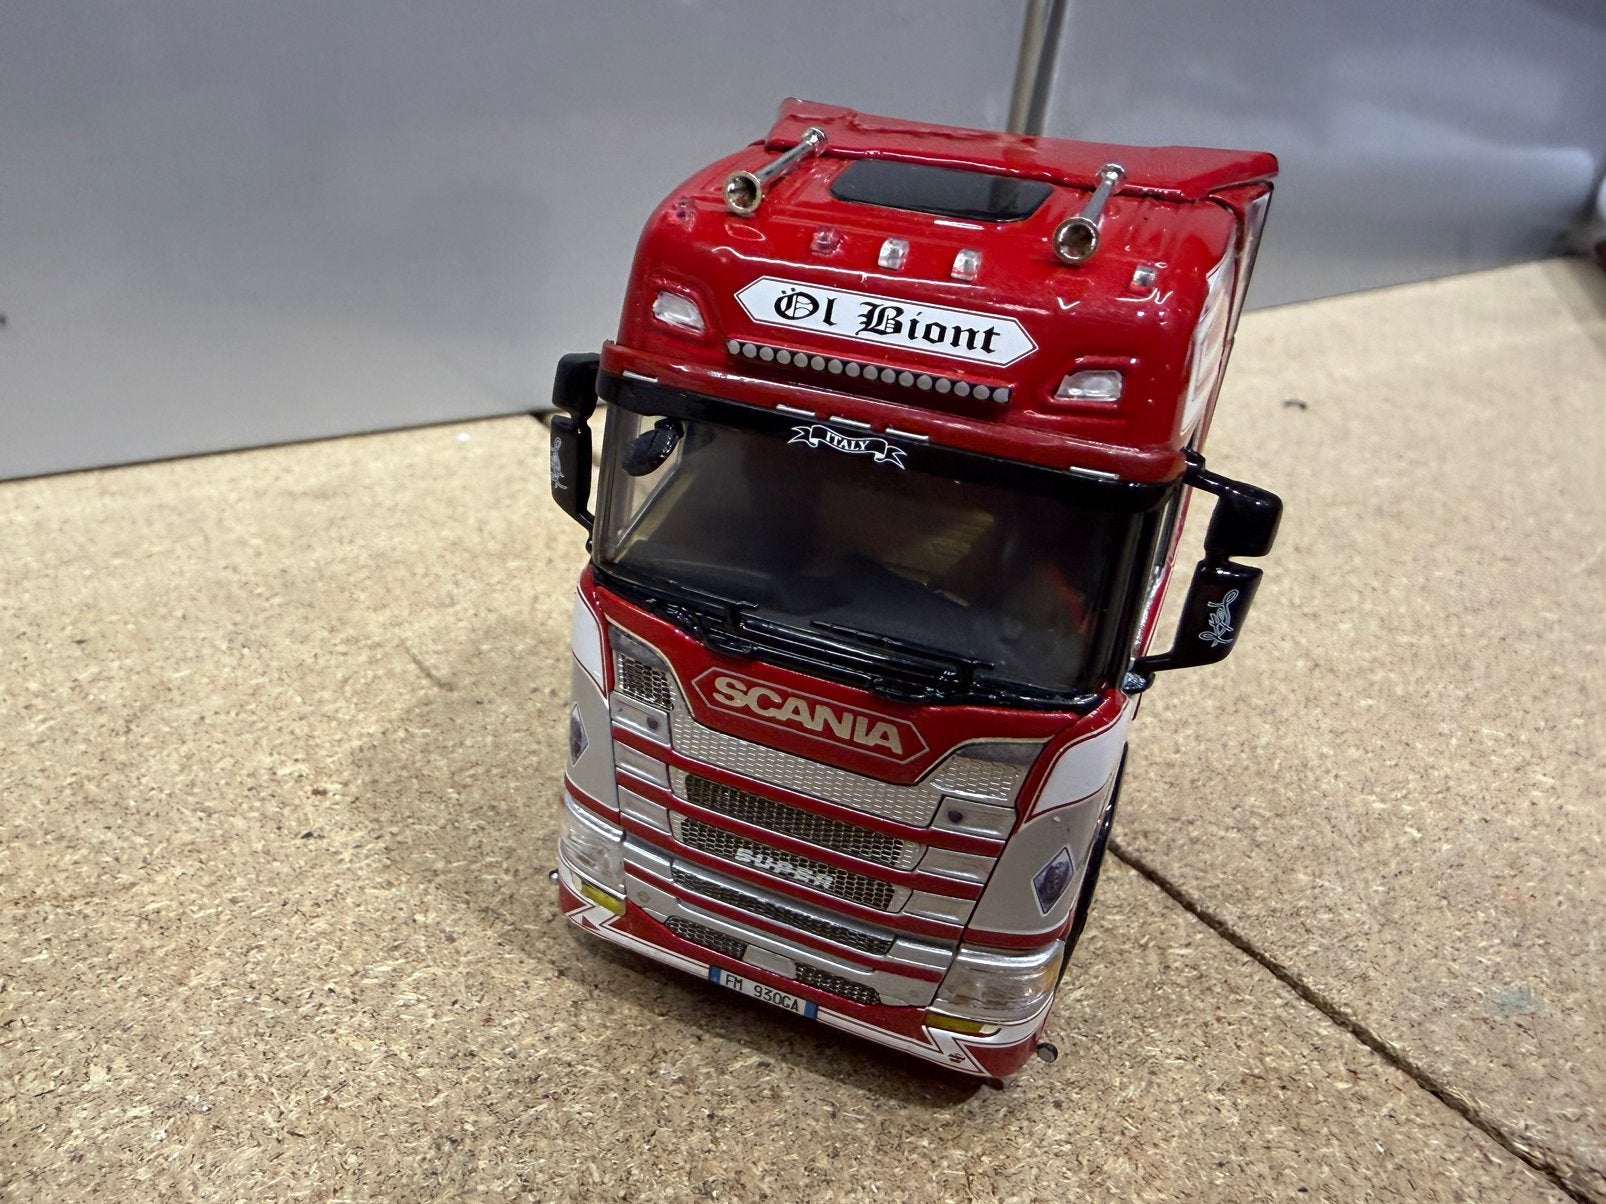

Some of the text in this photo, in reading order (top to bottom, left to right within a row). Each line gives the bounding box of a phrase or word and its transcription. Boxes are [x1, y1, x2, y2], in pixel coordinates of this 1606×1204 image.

[855, 301, 1001, 354] Biont
[825, 432, 870, 452] ITALY
[713, 676, 903, 755] SCANIA
[725, 974, 743, 991] FM
